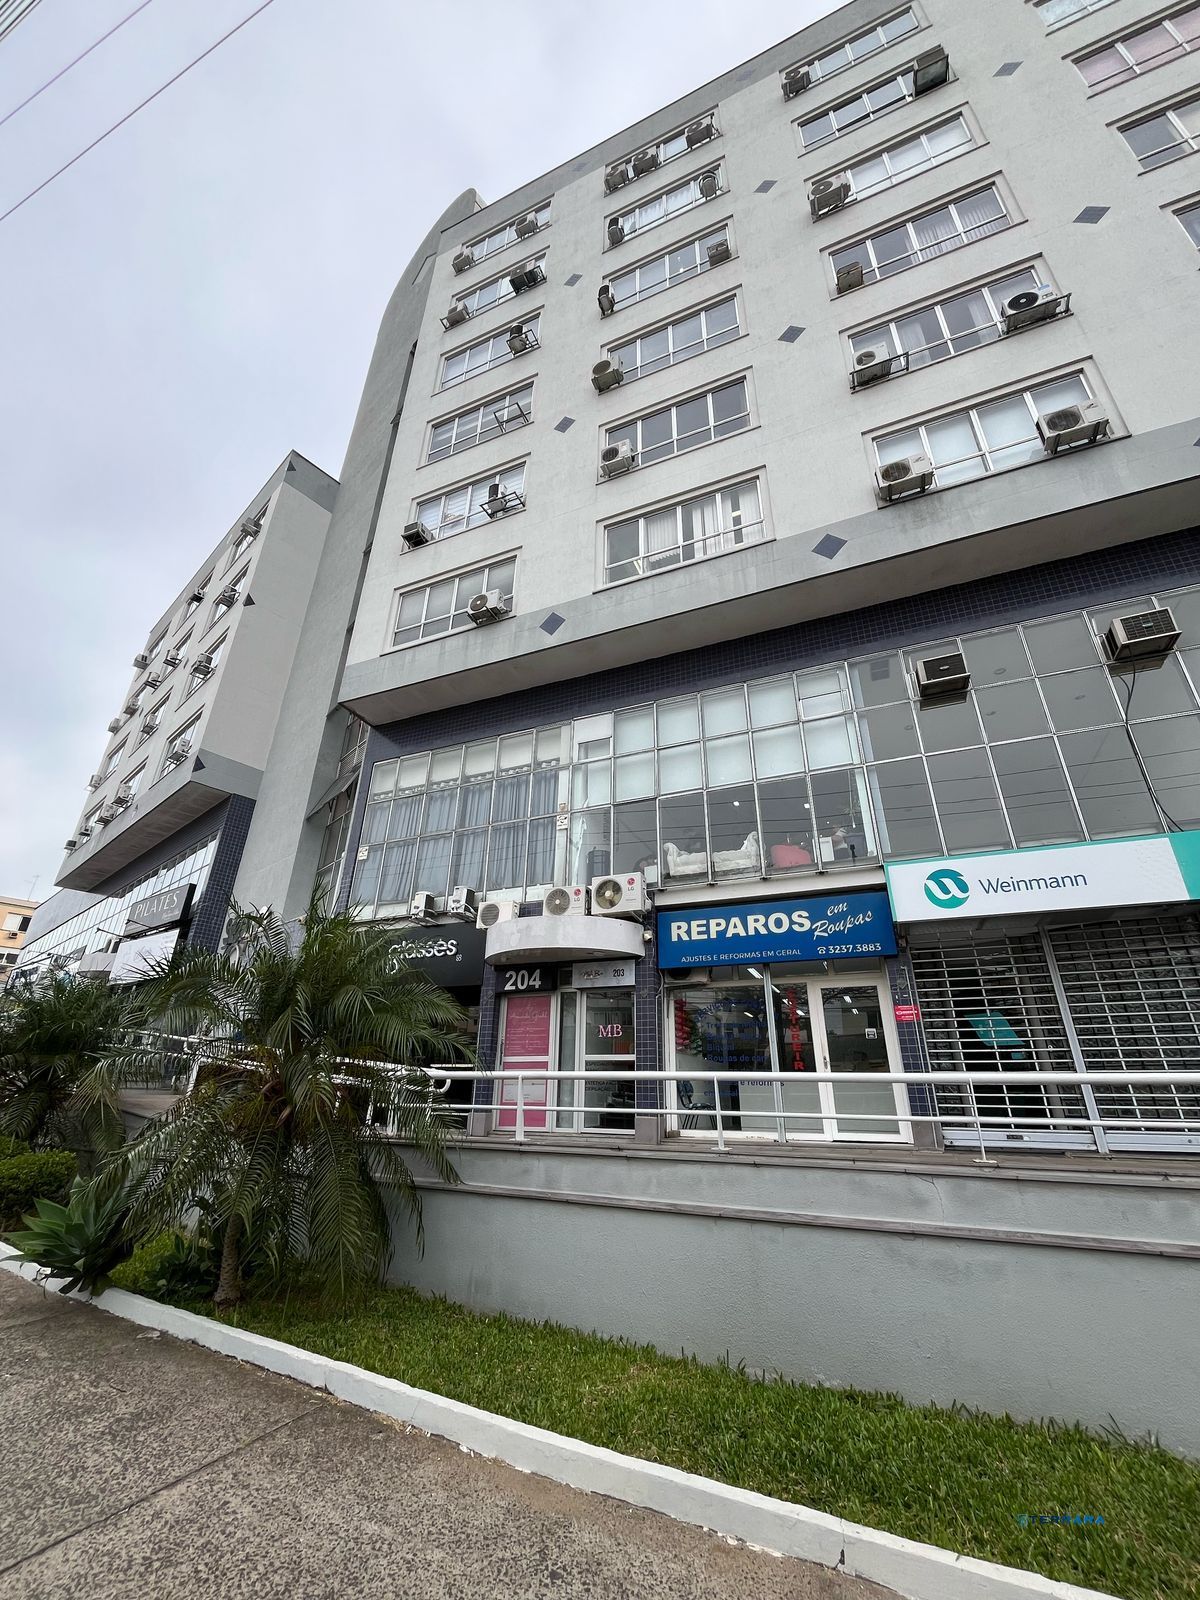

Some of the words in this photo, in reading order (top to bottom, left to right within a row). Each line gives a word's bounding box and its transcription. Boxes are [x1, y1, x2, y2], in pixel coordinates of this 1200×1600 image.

[978, 873, 1088, 894] Weinmann
[134, 891, 180, 919] PILATES
[827, 902, 848, 916] em
[671, 910, 811, 942] REPAROS
[811, 910, 873, 940] Roupas
[681, 955, 712, 963] AJUSTES
[720, 952, 761, 960] REFORMAS
[776, 948, 801, 956] GERAL
[828, 943, 881, 954] 3237.3883
[504, 968, 542, 991] 204
[612, 968, 625, 978] 203
[598, 1023, 623, 1037] MB
